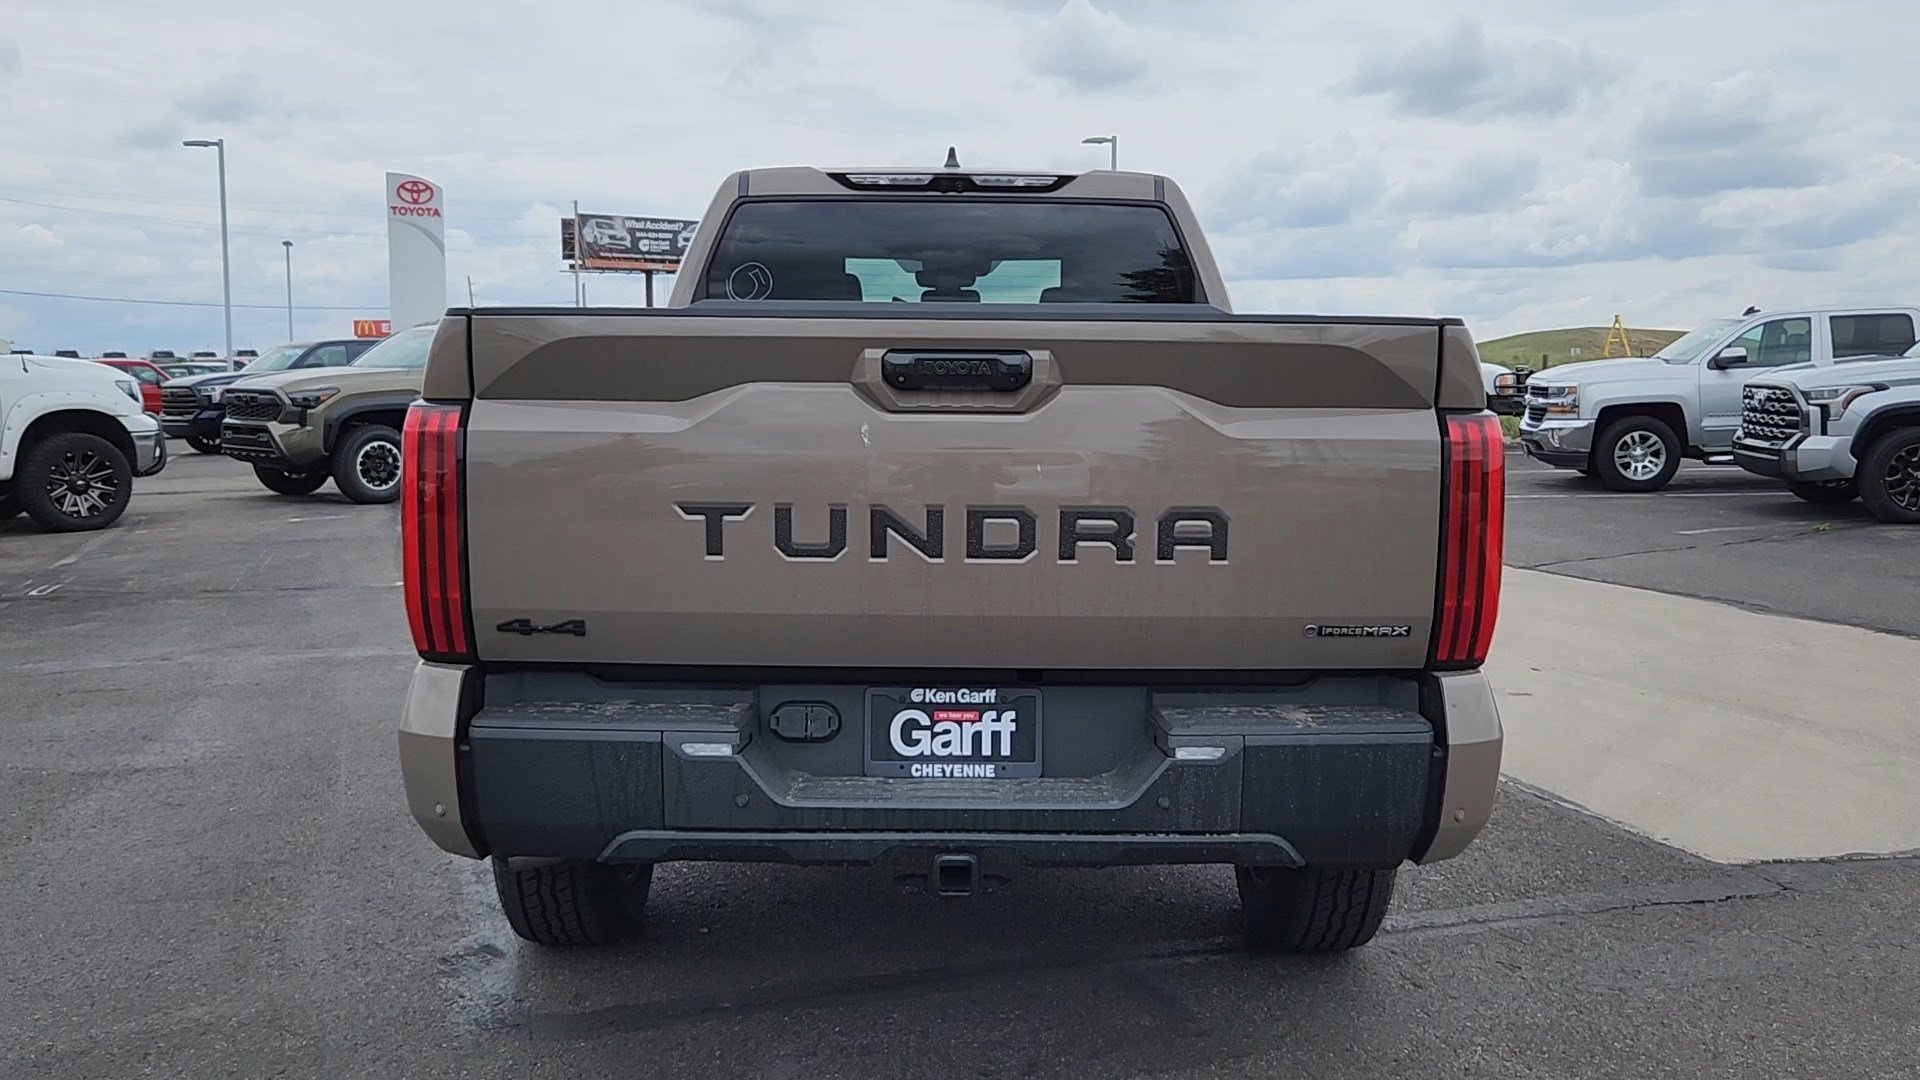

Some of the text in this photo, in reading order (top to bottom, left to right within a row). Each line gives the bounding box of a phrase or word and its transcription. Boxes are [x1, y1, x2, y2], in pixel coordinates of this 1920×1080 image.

[390, 206, 442, 218] TOYOTA
[624, 219, 684, 231] What Accident?
[923, 360, 991, 375] TOYOTA
[672, 503, 1230, 566] TUNDRA
[925, 688, 997, 704] Ken Garff
[963, 712, 975, 720] you
[889, 709, 1017, 757] Garff
[910, 763, 996, 778] CHEYENNE
